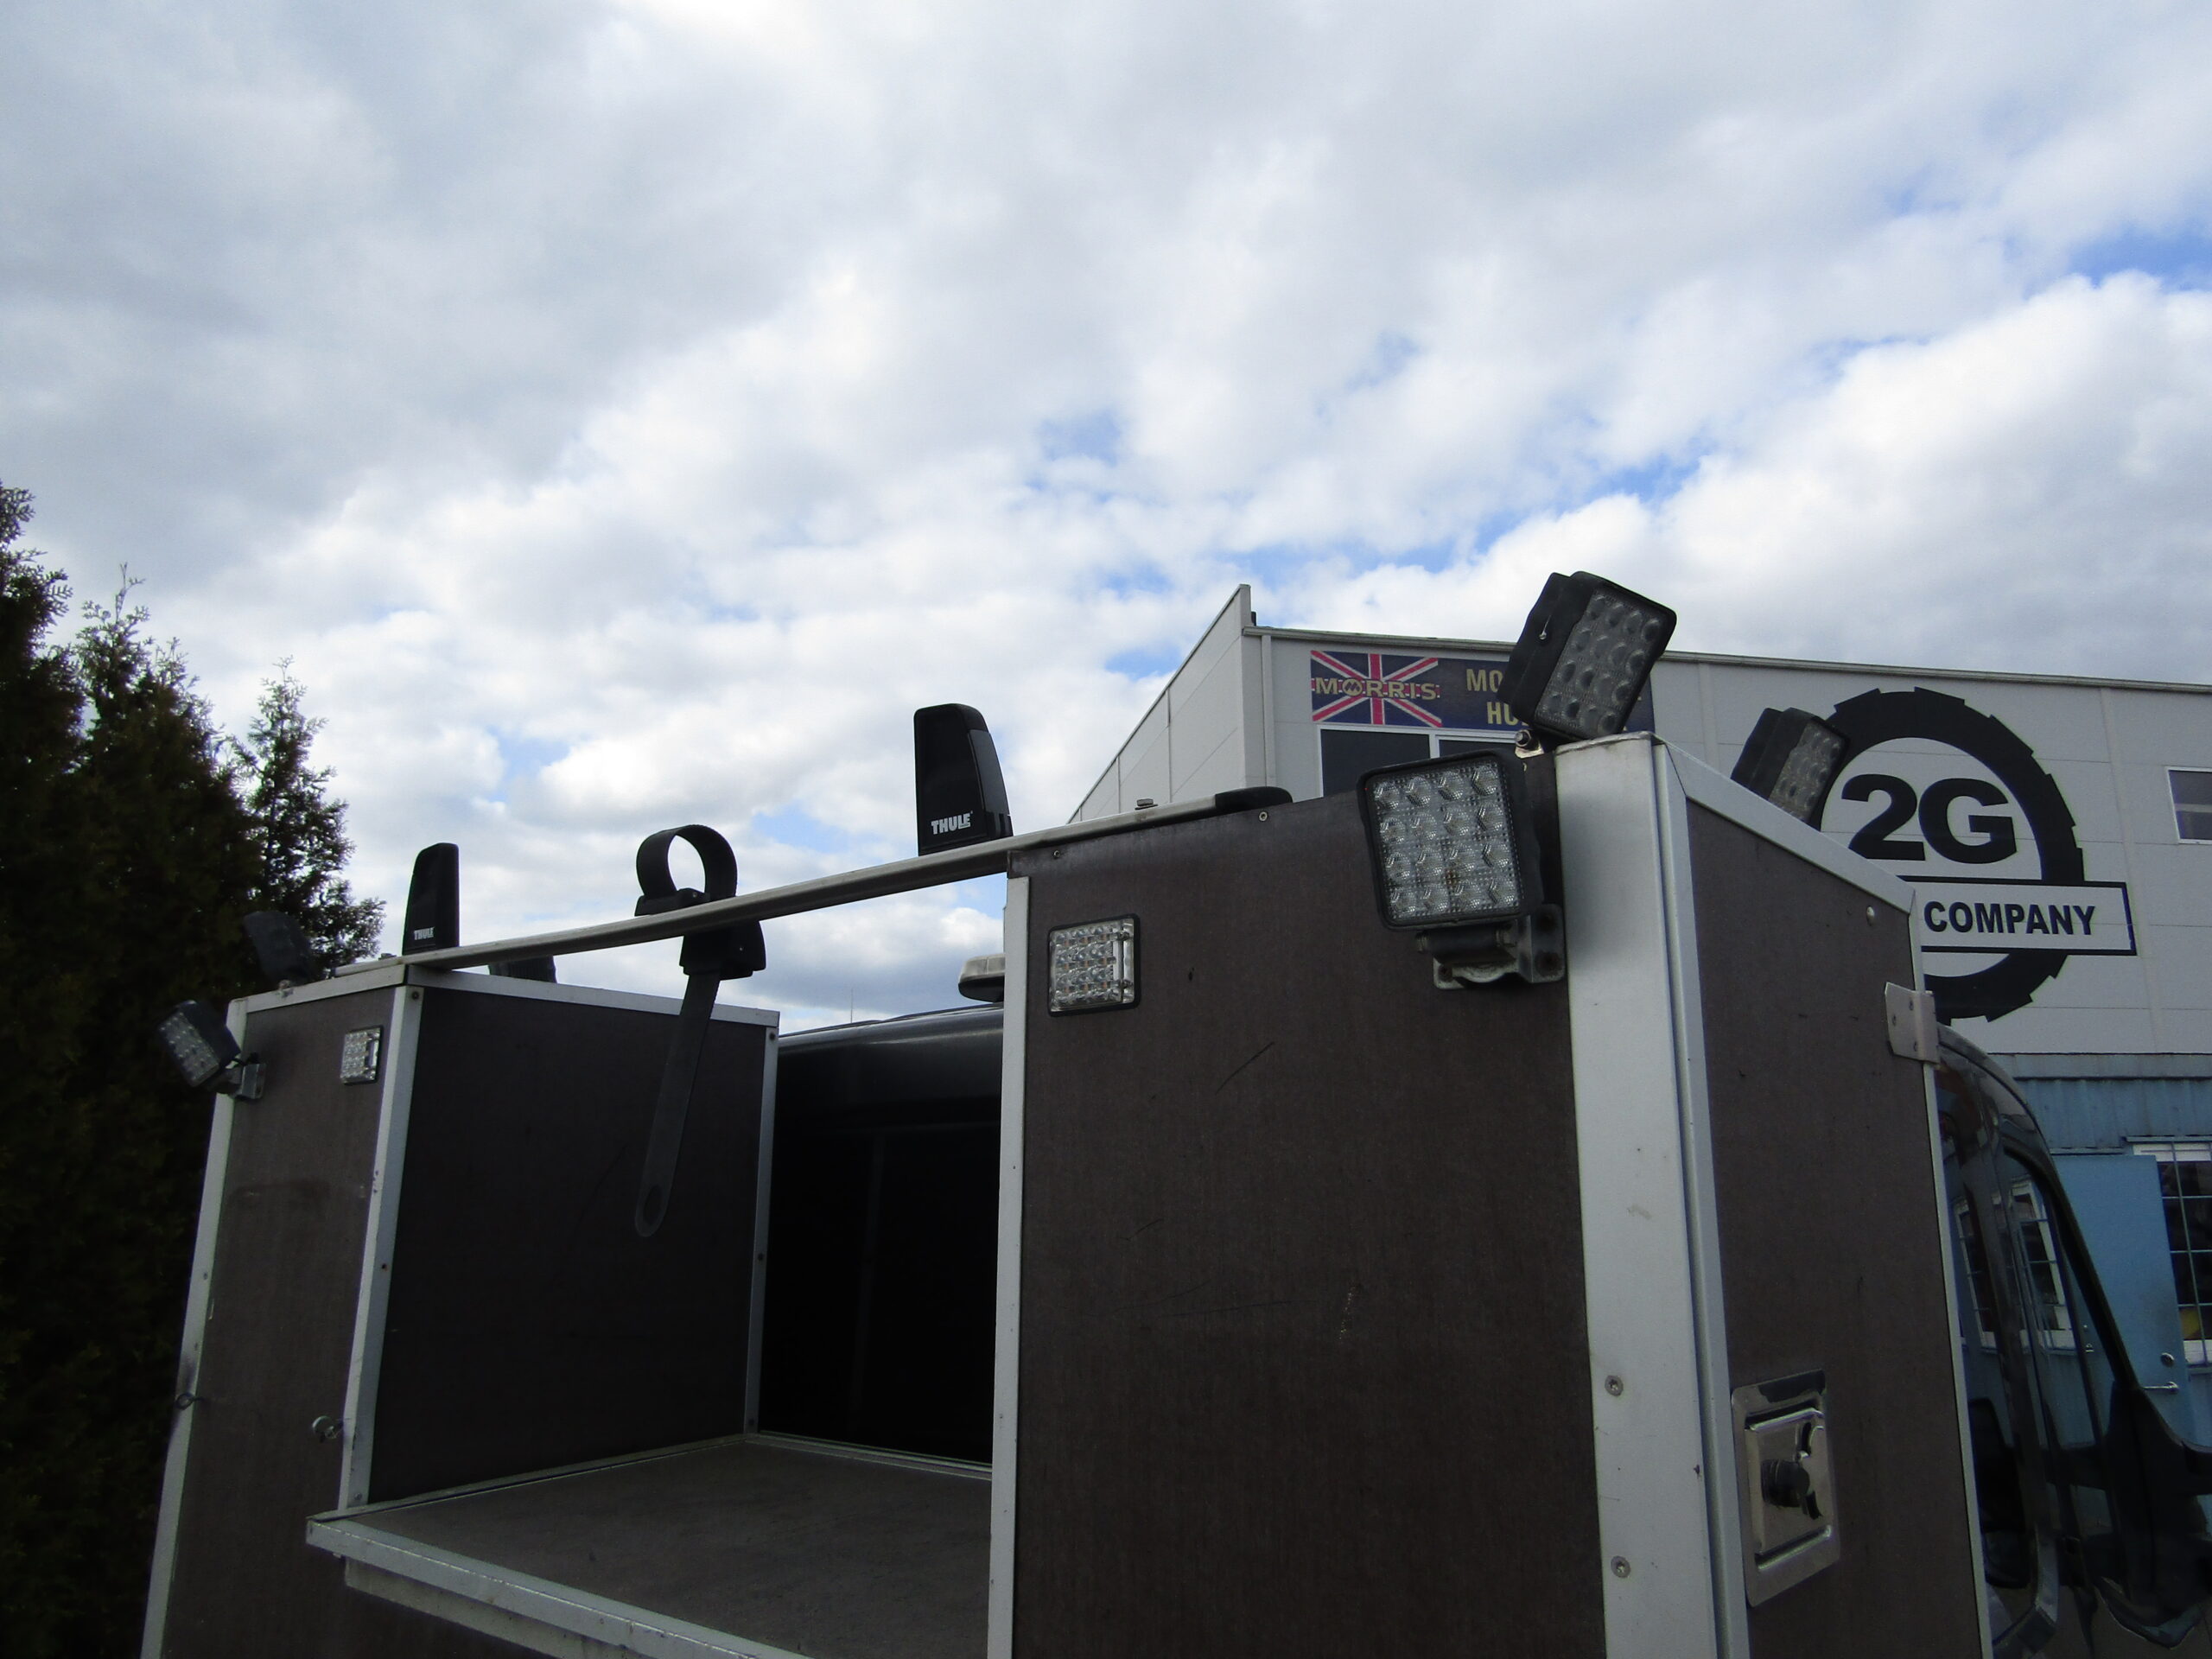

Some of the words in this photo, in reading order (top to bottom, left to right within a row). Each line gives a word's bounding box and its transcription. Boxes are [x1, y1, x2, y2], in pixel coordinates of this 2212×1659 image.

[1315, 677, 1437, 701] MORRIS
[1466, 668, 1504, 693] MO
[931, 812, 971, 835] THULE
[1841, 773, 2018, 864] 2G
[1923, 900, 2096, 936] COMPANY
[414, 926, 435, 940] THULE
